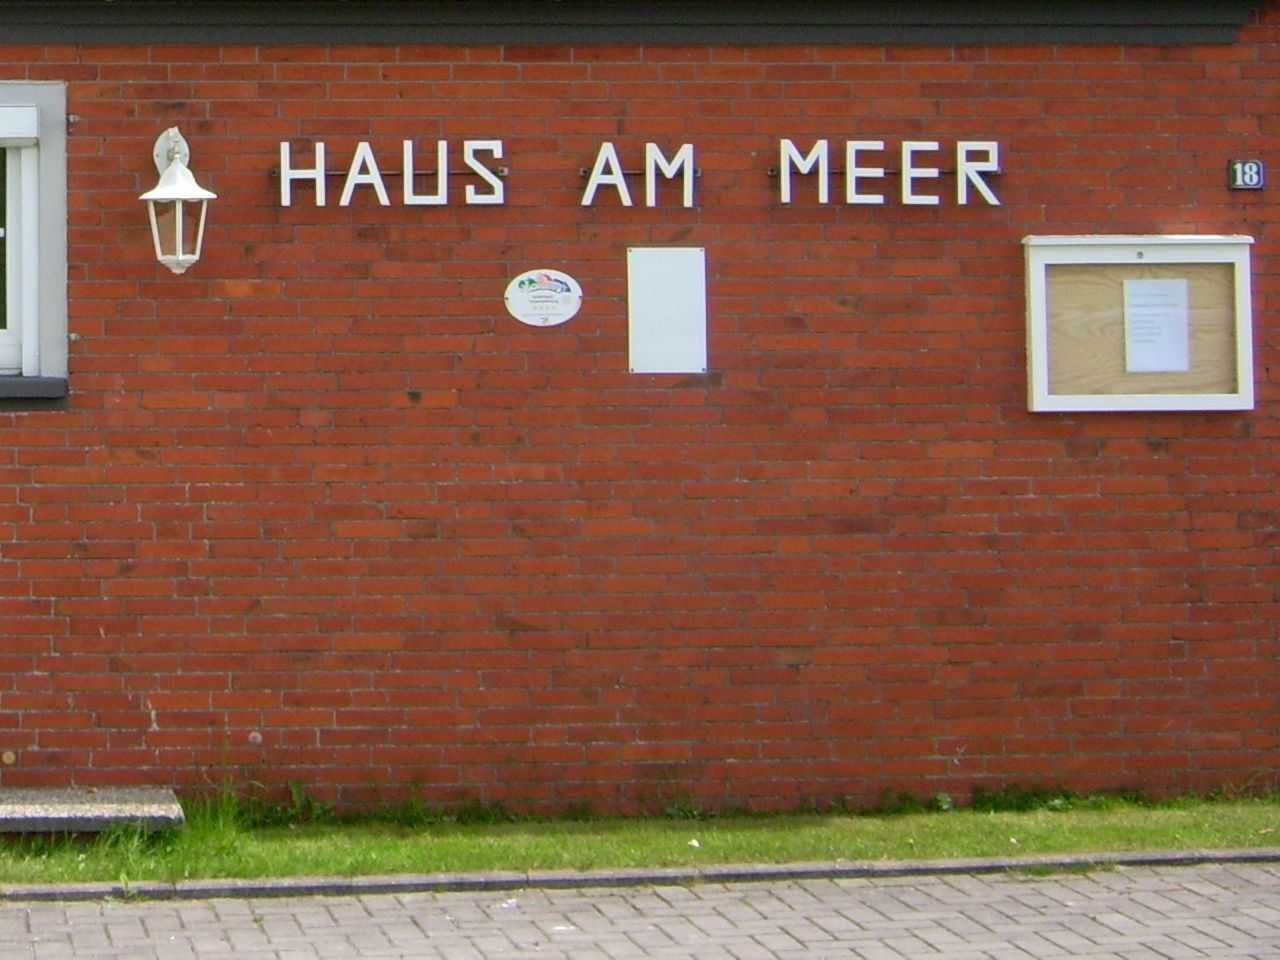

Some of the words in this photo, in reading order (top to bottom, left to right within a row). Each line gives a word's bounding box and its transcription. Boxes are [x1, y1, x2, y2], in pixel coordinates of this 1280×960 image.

[280, 140, 504, 206] HAUS
[581, 142, 694, 207] AM
[780, 139, 1001, 205] MEER
[1233, 162, 1259, 186] 18
